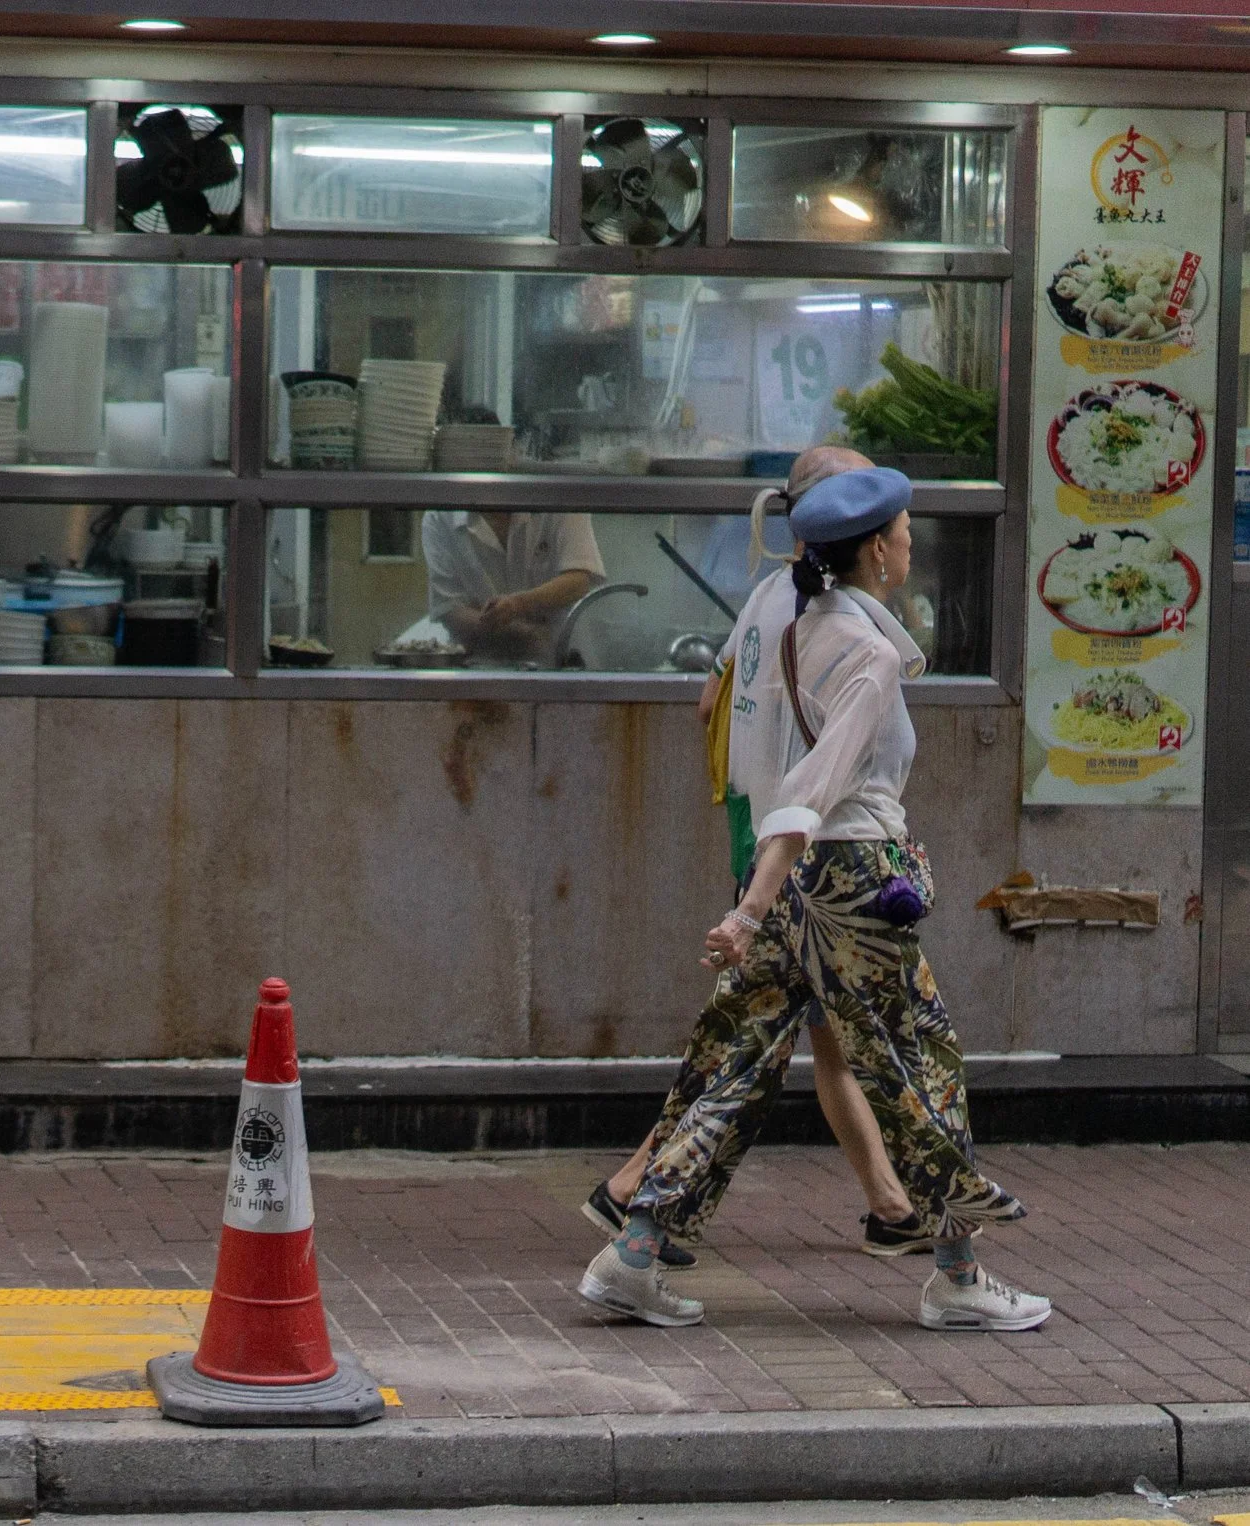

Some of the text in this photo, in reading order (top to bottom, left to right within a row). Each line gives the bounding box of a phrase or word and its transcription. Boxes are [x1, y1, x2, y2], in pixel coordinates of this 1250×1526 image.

[1110, 124, 1149, 206] 文輝
[771, 333, 830, 402] 19
[233, 1174, 277, 1197] 培興
[248, 1198, 284, 1212] HING
